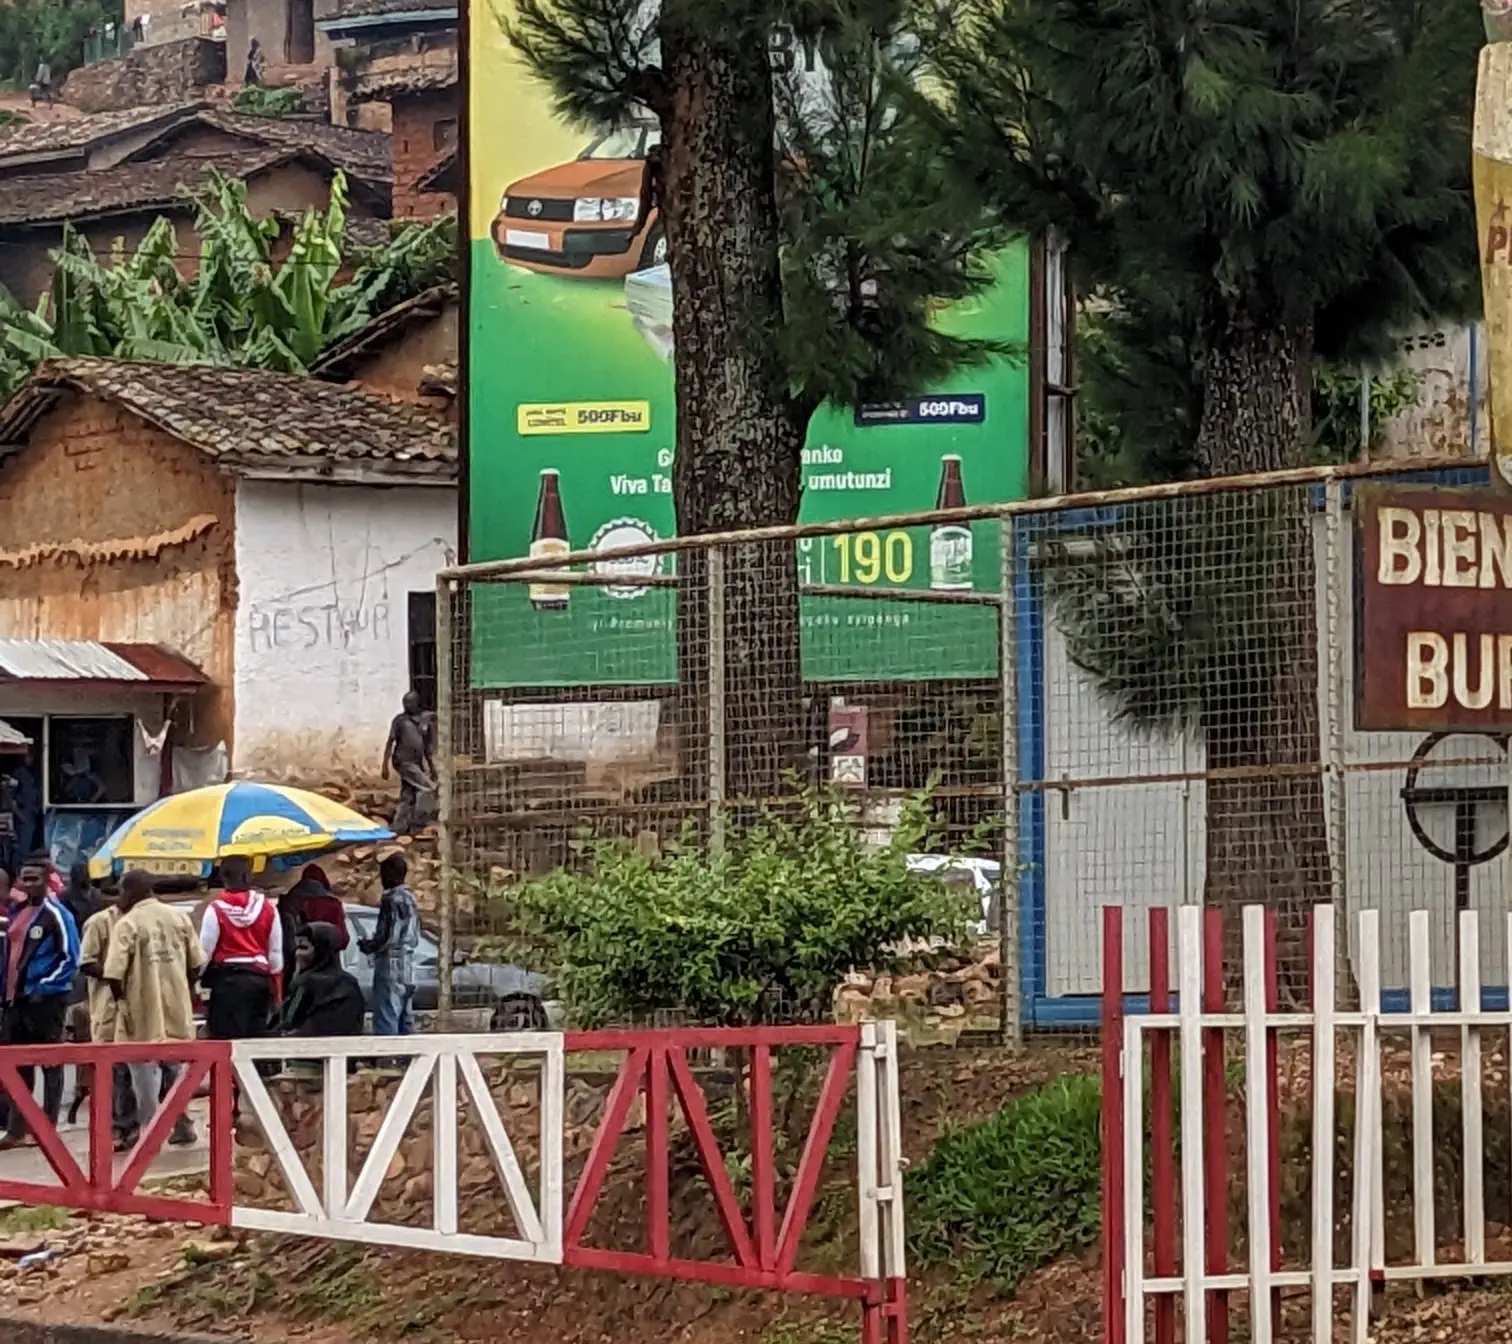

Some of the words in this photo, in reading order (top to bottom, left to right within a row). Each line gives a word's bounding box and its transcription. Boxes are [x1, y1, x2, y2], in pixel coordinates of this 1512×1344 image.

[610, 474, 648, 495] Viva
[808, 467, 892, 491] umutunzi
[832, 531, 914, 584] 190
